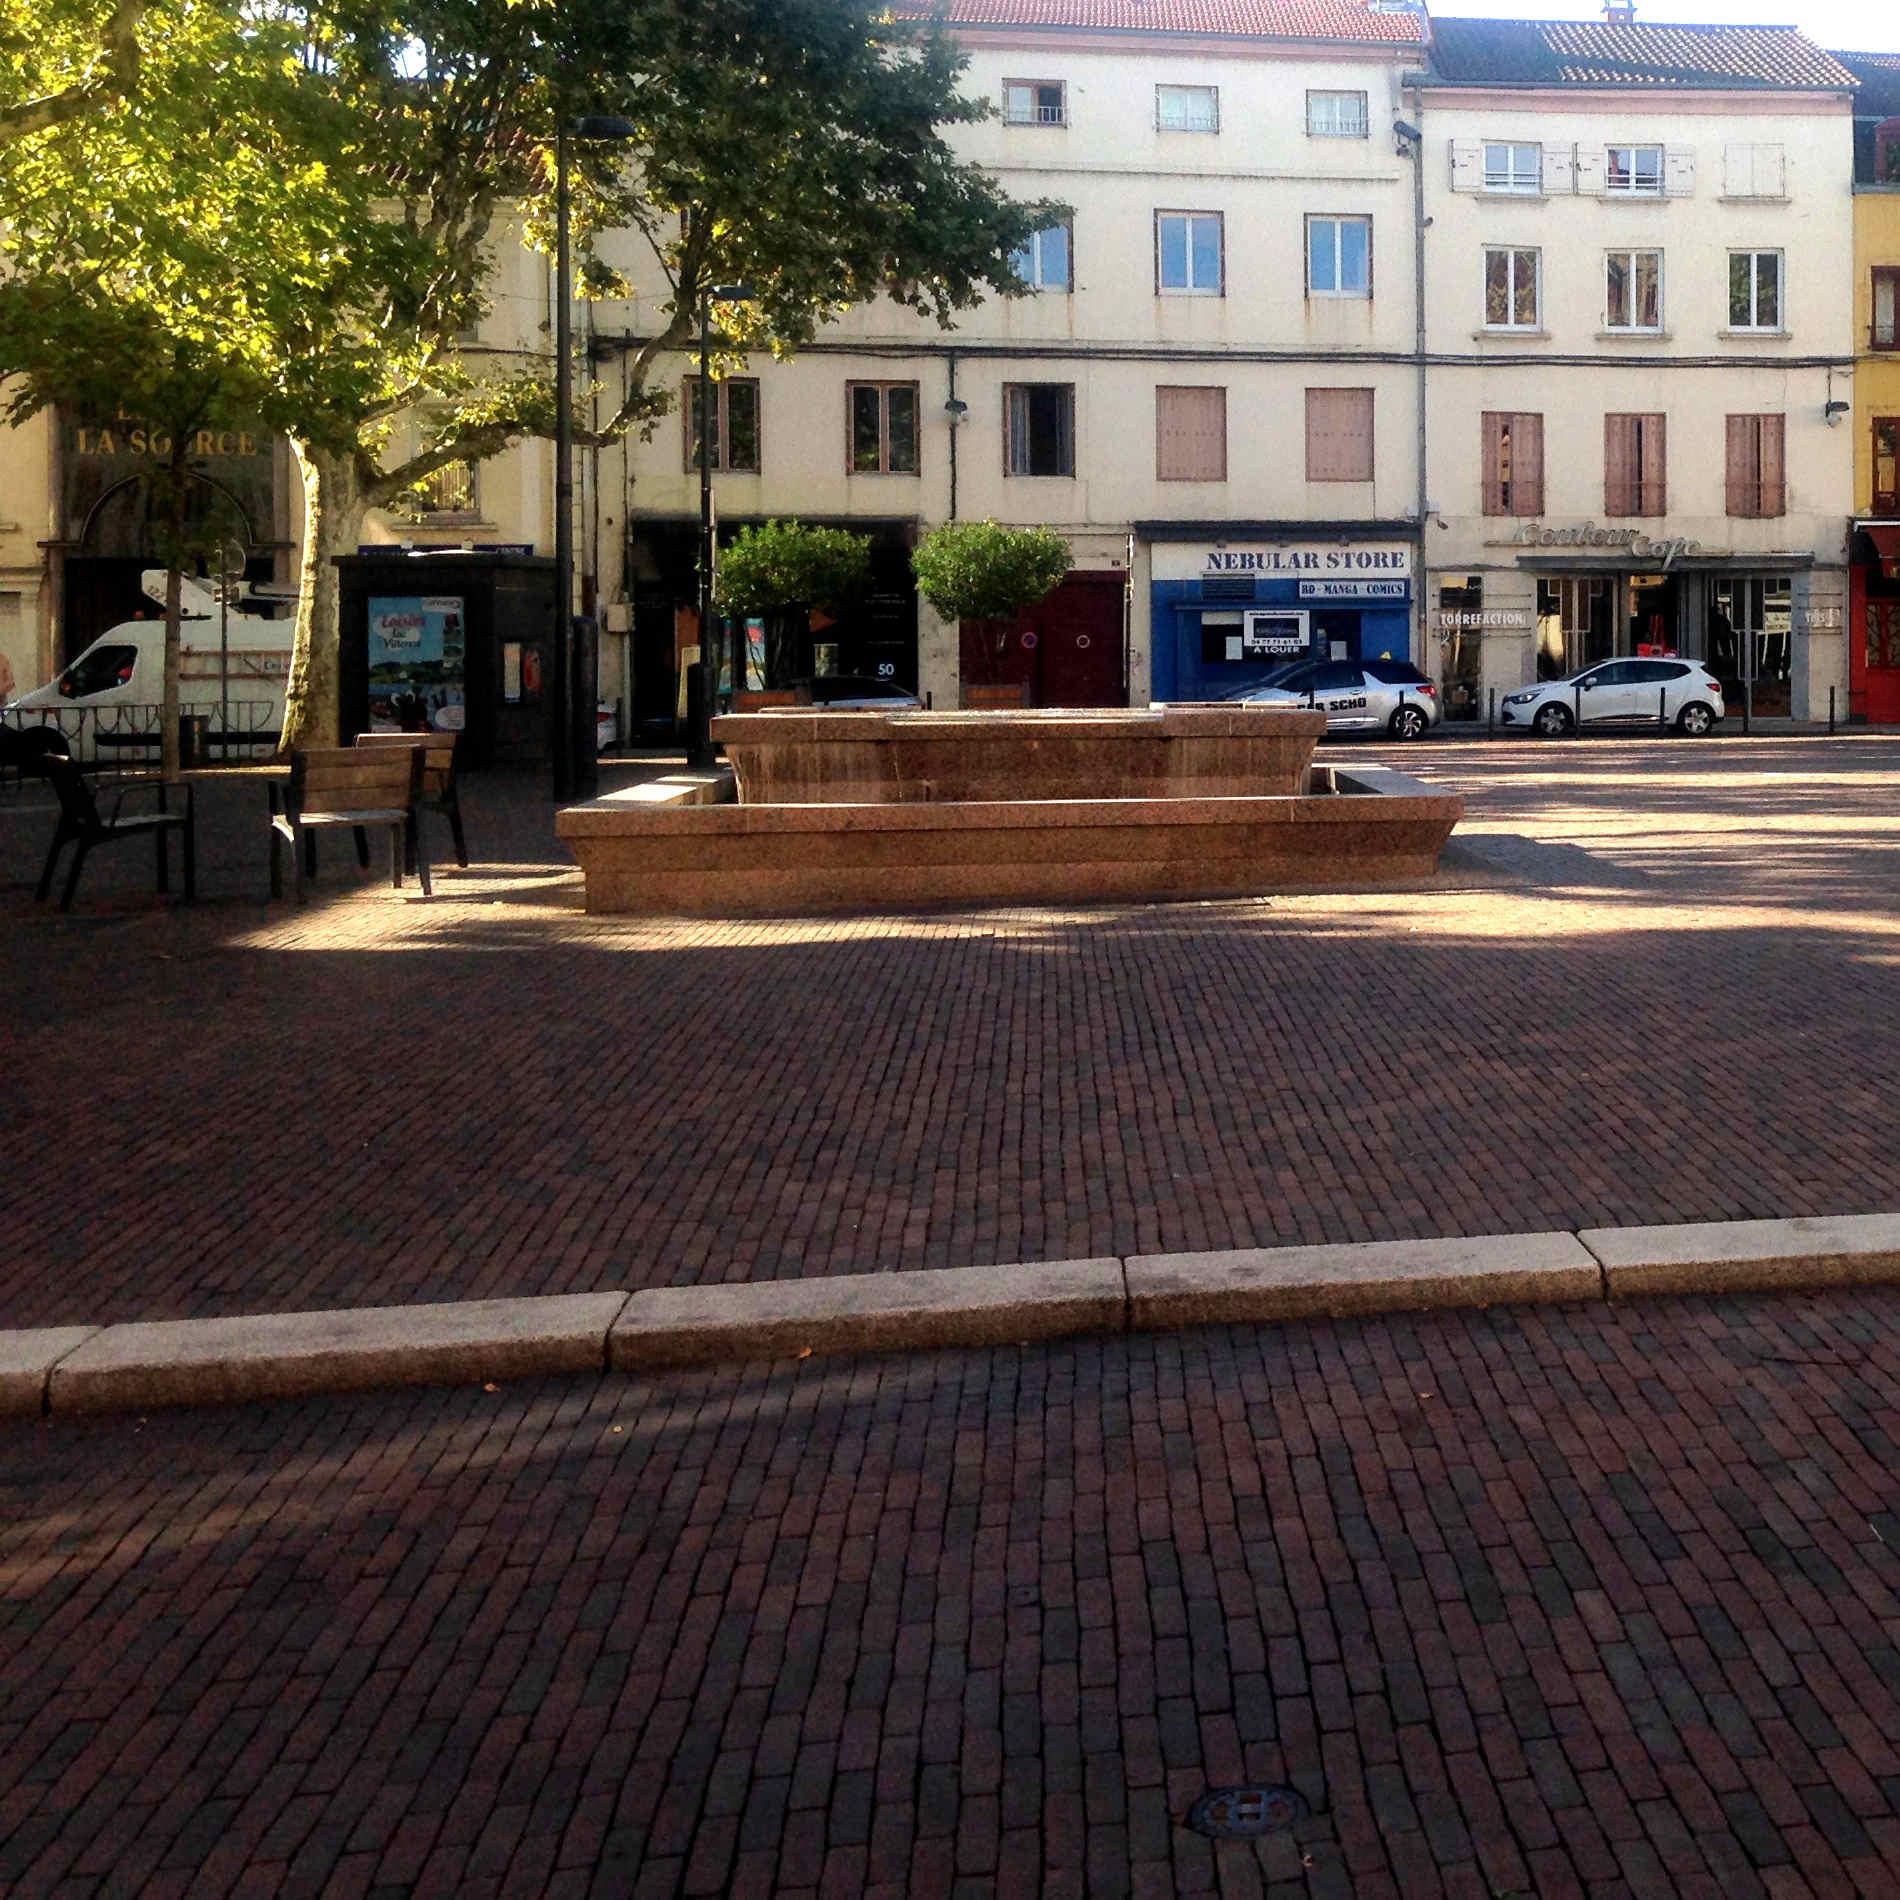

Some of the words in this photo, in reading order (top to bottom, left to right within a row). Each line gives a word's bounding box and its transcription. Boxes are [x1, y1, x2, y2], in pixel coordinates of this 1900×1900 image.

[79, 429, 116, 456] LA
[131, 429, 257, 457] SORCE
[1518, 521, 1640, 547] Couleur
[1206, 552, 1320, 571] NEBULAR
[1325, 552, 1405, 569] STORE
[1324, 584, 1359, 595] MANGA
[1366, 584, 1403, 595] COMICS
[877, 663, 895, 676] 50
[1330, 698, 1367, 711] SCHO
